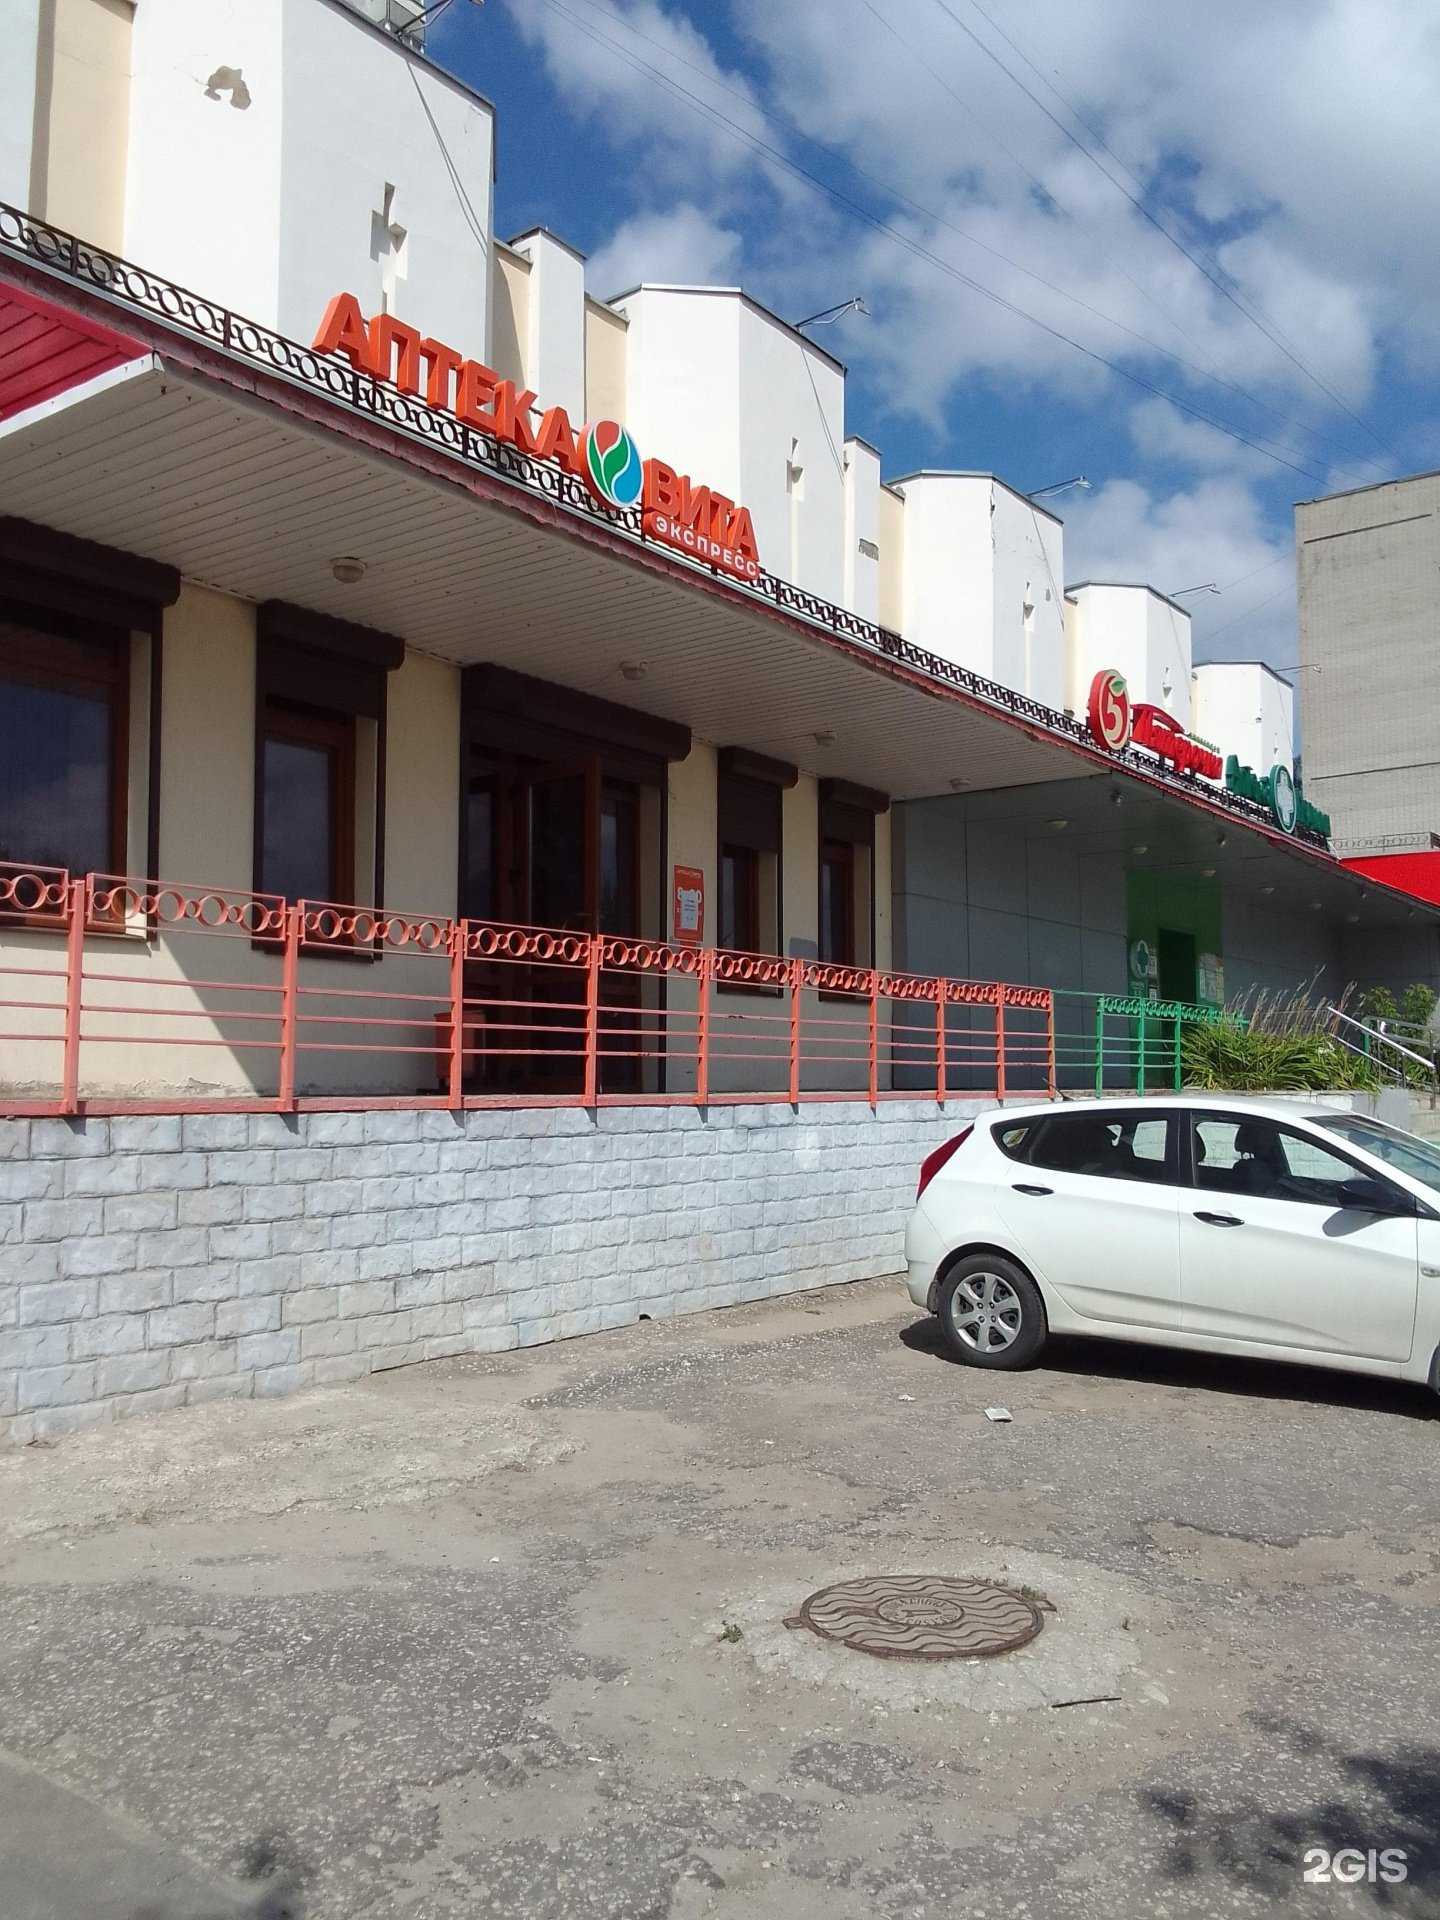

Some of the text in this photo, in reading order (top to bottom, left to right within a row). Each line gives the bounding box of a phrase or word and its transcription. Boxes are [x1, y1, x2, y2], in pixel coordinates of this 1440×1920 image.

[312, 292, 760, 562] АПТЕКА ВИТА
[655, 515, 757, 577] ЭКСПРЕСС
